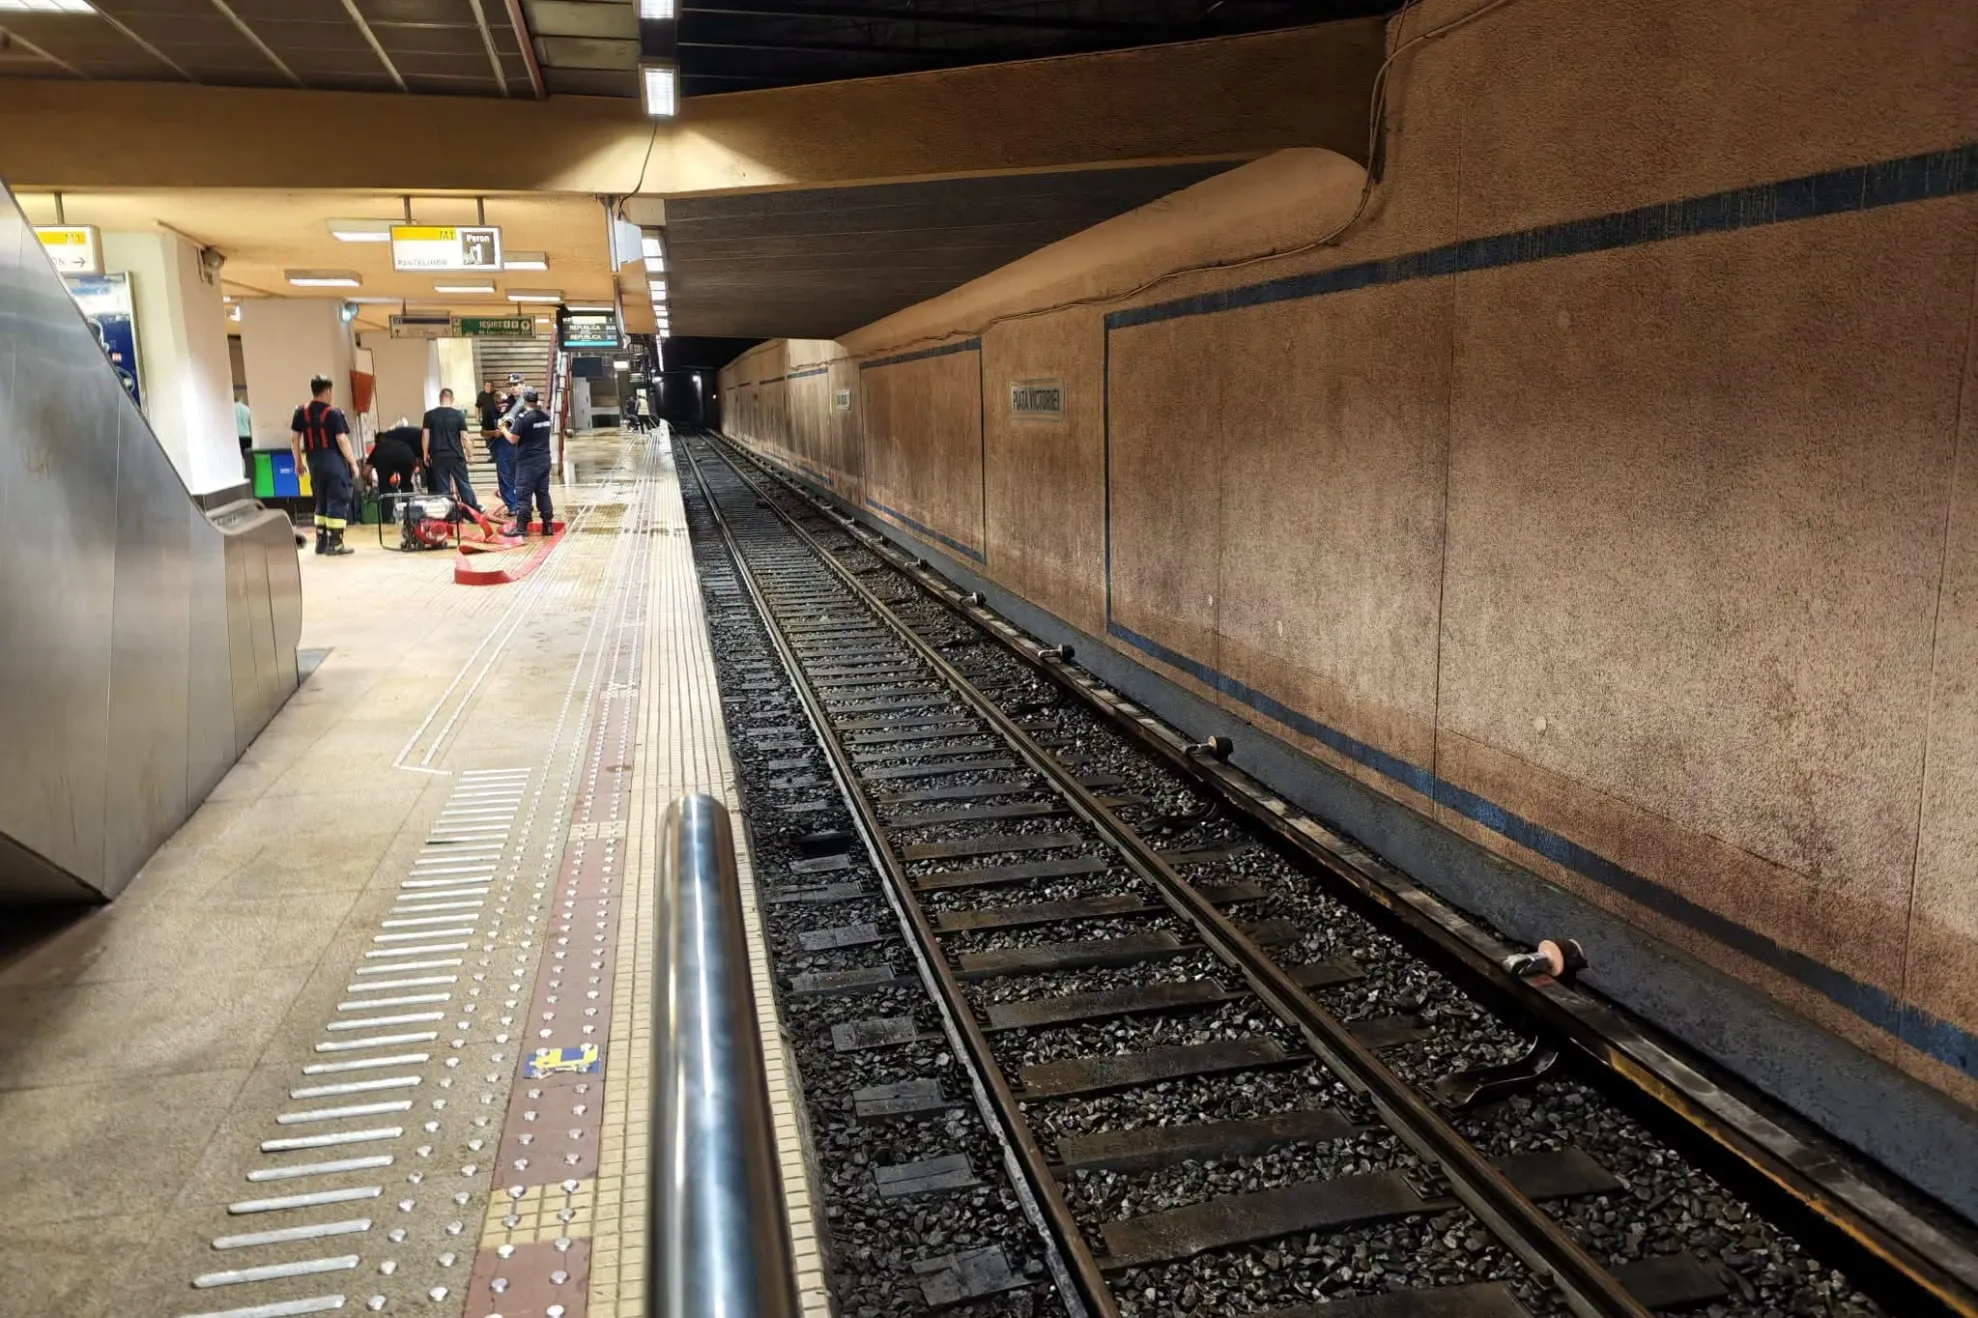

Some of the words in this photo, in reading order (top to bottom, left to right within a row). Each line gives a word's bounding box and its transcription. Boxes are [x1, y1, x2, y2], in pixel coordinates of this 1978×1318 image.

[439, 229, 455, 240] M1
[466, 233, 490, 243] Peron
[397, 259, 448, 267] PANTELIMON
